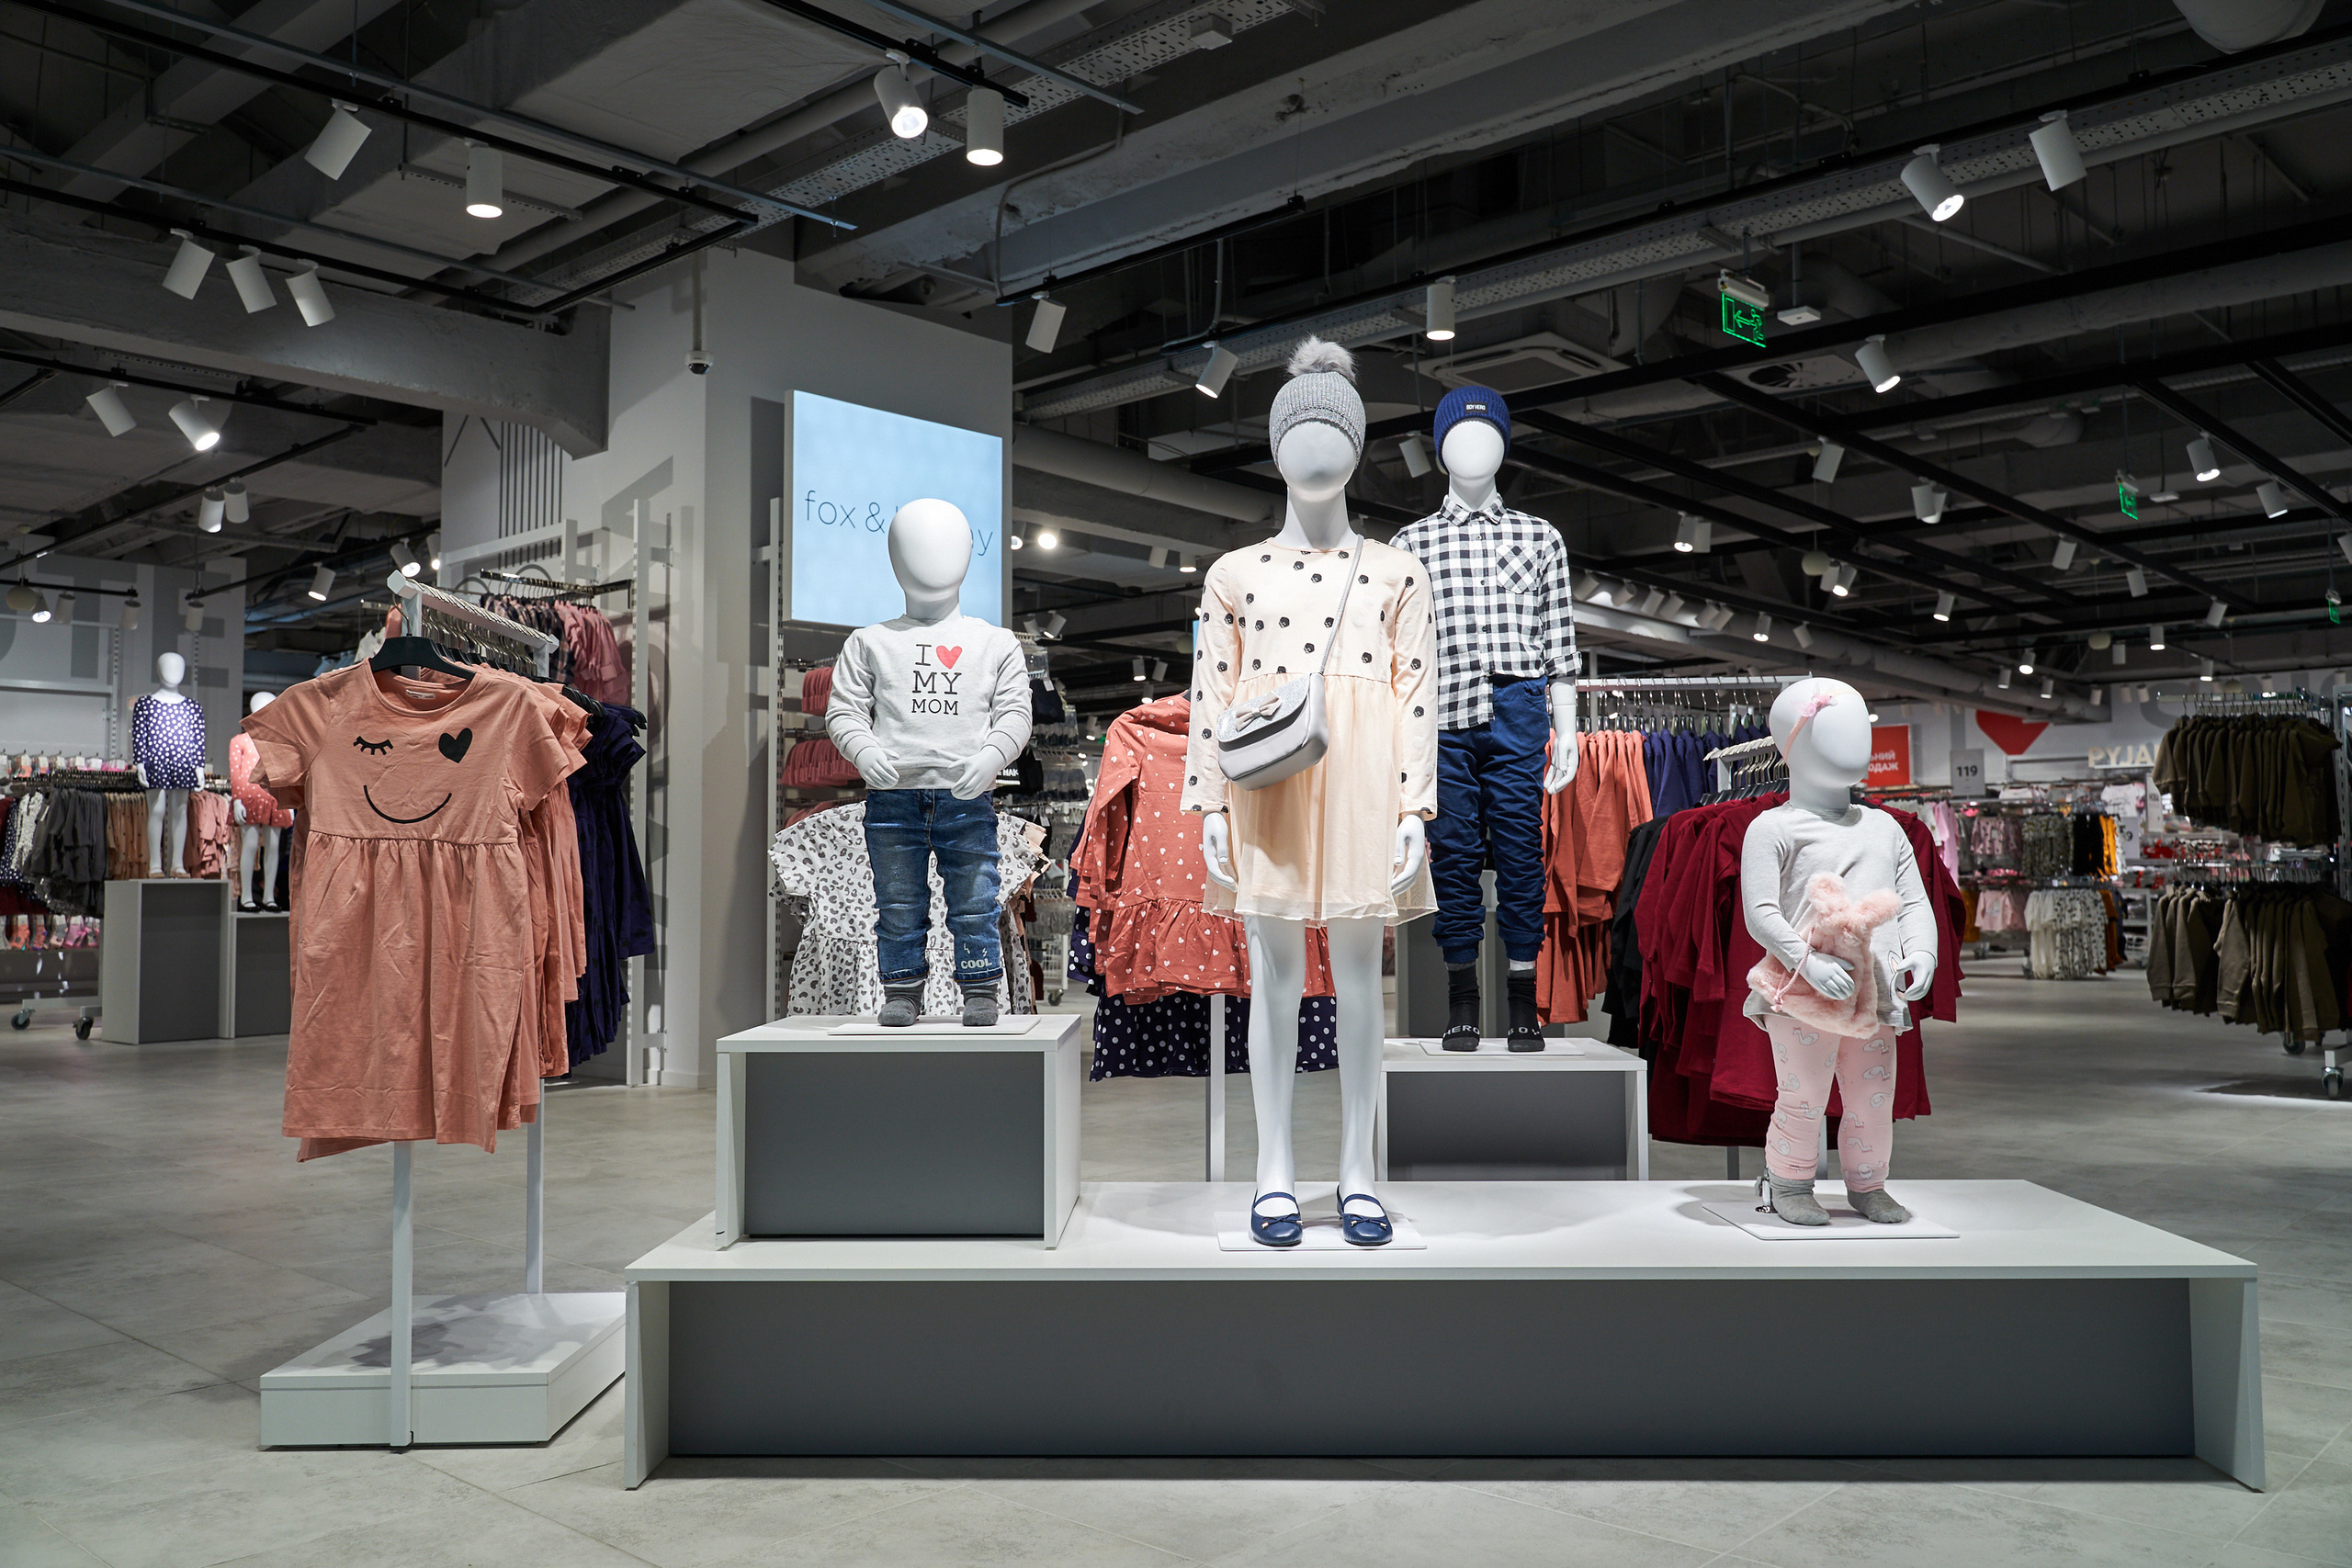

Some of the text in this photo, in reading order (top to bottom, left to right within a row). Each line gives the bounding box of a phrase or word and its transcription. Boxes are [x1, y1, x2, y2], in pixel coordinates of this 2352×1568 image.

[805, 490, 855, 529] fox
[915, 644, 932, 666] I
[912, 671, 962, 694] MY
[911, 699, 958, 716] MOM
[2088, 744, 2160, 768] PYJA
[1956, 765, 1978, 777] 119
[961, 958, 992, 970] COOL
[1442, 1024, 1480, 1038] HERO
